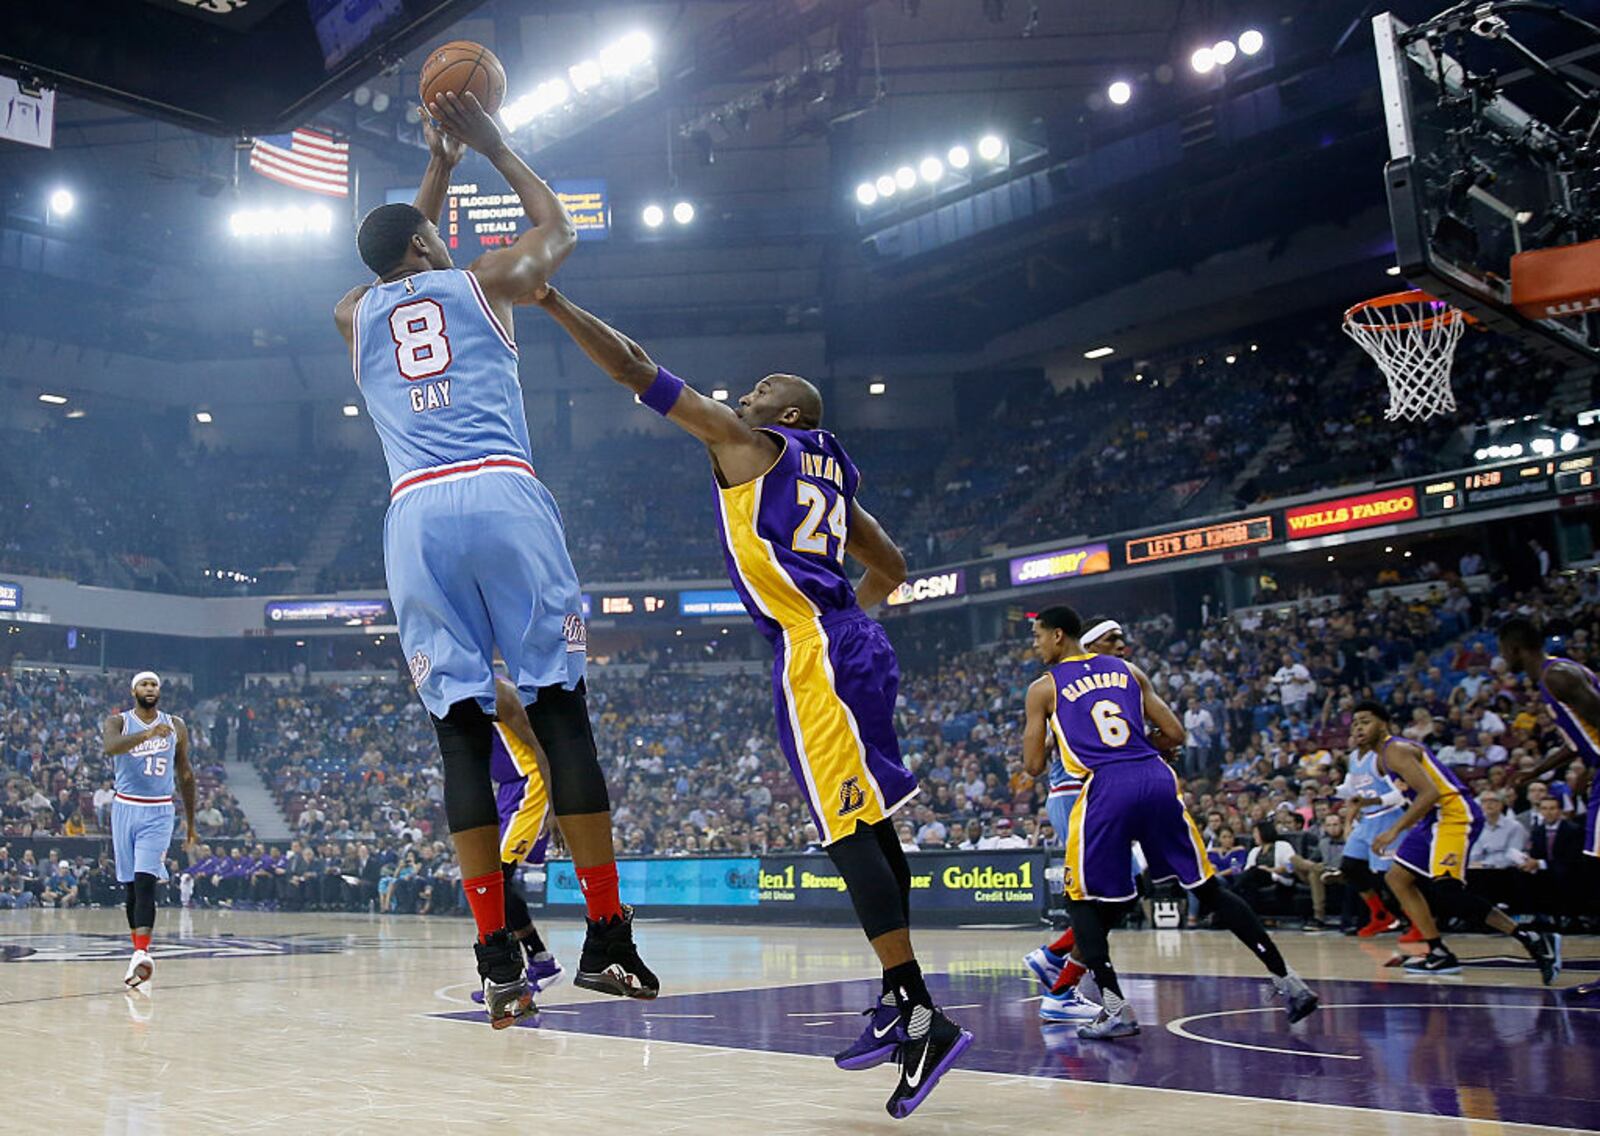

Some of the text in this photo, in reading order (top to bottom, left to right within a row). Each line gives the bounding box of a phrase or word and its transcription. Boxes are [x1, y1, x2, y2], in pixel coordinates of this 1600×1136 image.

[460, 195, 501, 207] BLOCKED
[475, 221, 516, 233] STEALS
[388, 298, 453, 381] 8
[410, 379, 451, 413] GAY
[791, 479, 848, 567] 24
[1289, 496, 1414, 530] WELLS FARGO
[1018, 551, 1087, 581] SUBWAY
[914, 573, 957, 601] CSN
[1061, 672, 1128, 702] CLARKSON
[1090, 699, 1131, 748] 6
[144, 756, 168, 776] 15
[801, 872, 847, 891] Strong
[943, 861, 1033, 889] Golden1
[975, 890, 1033, 902] Credit Union
